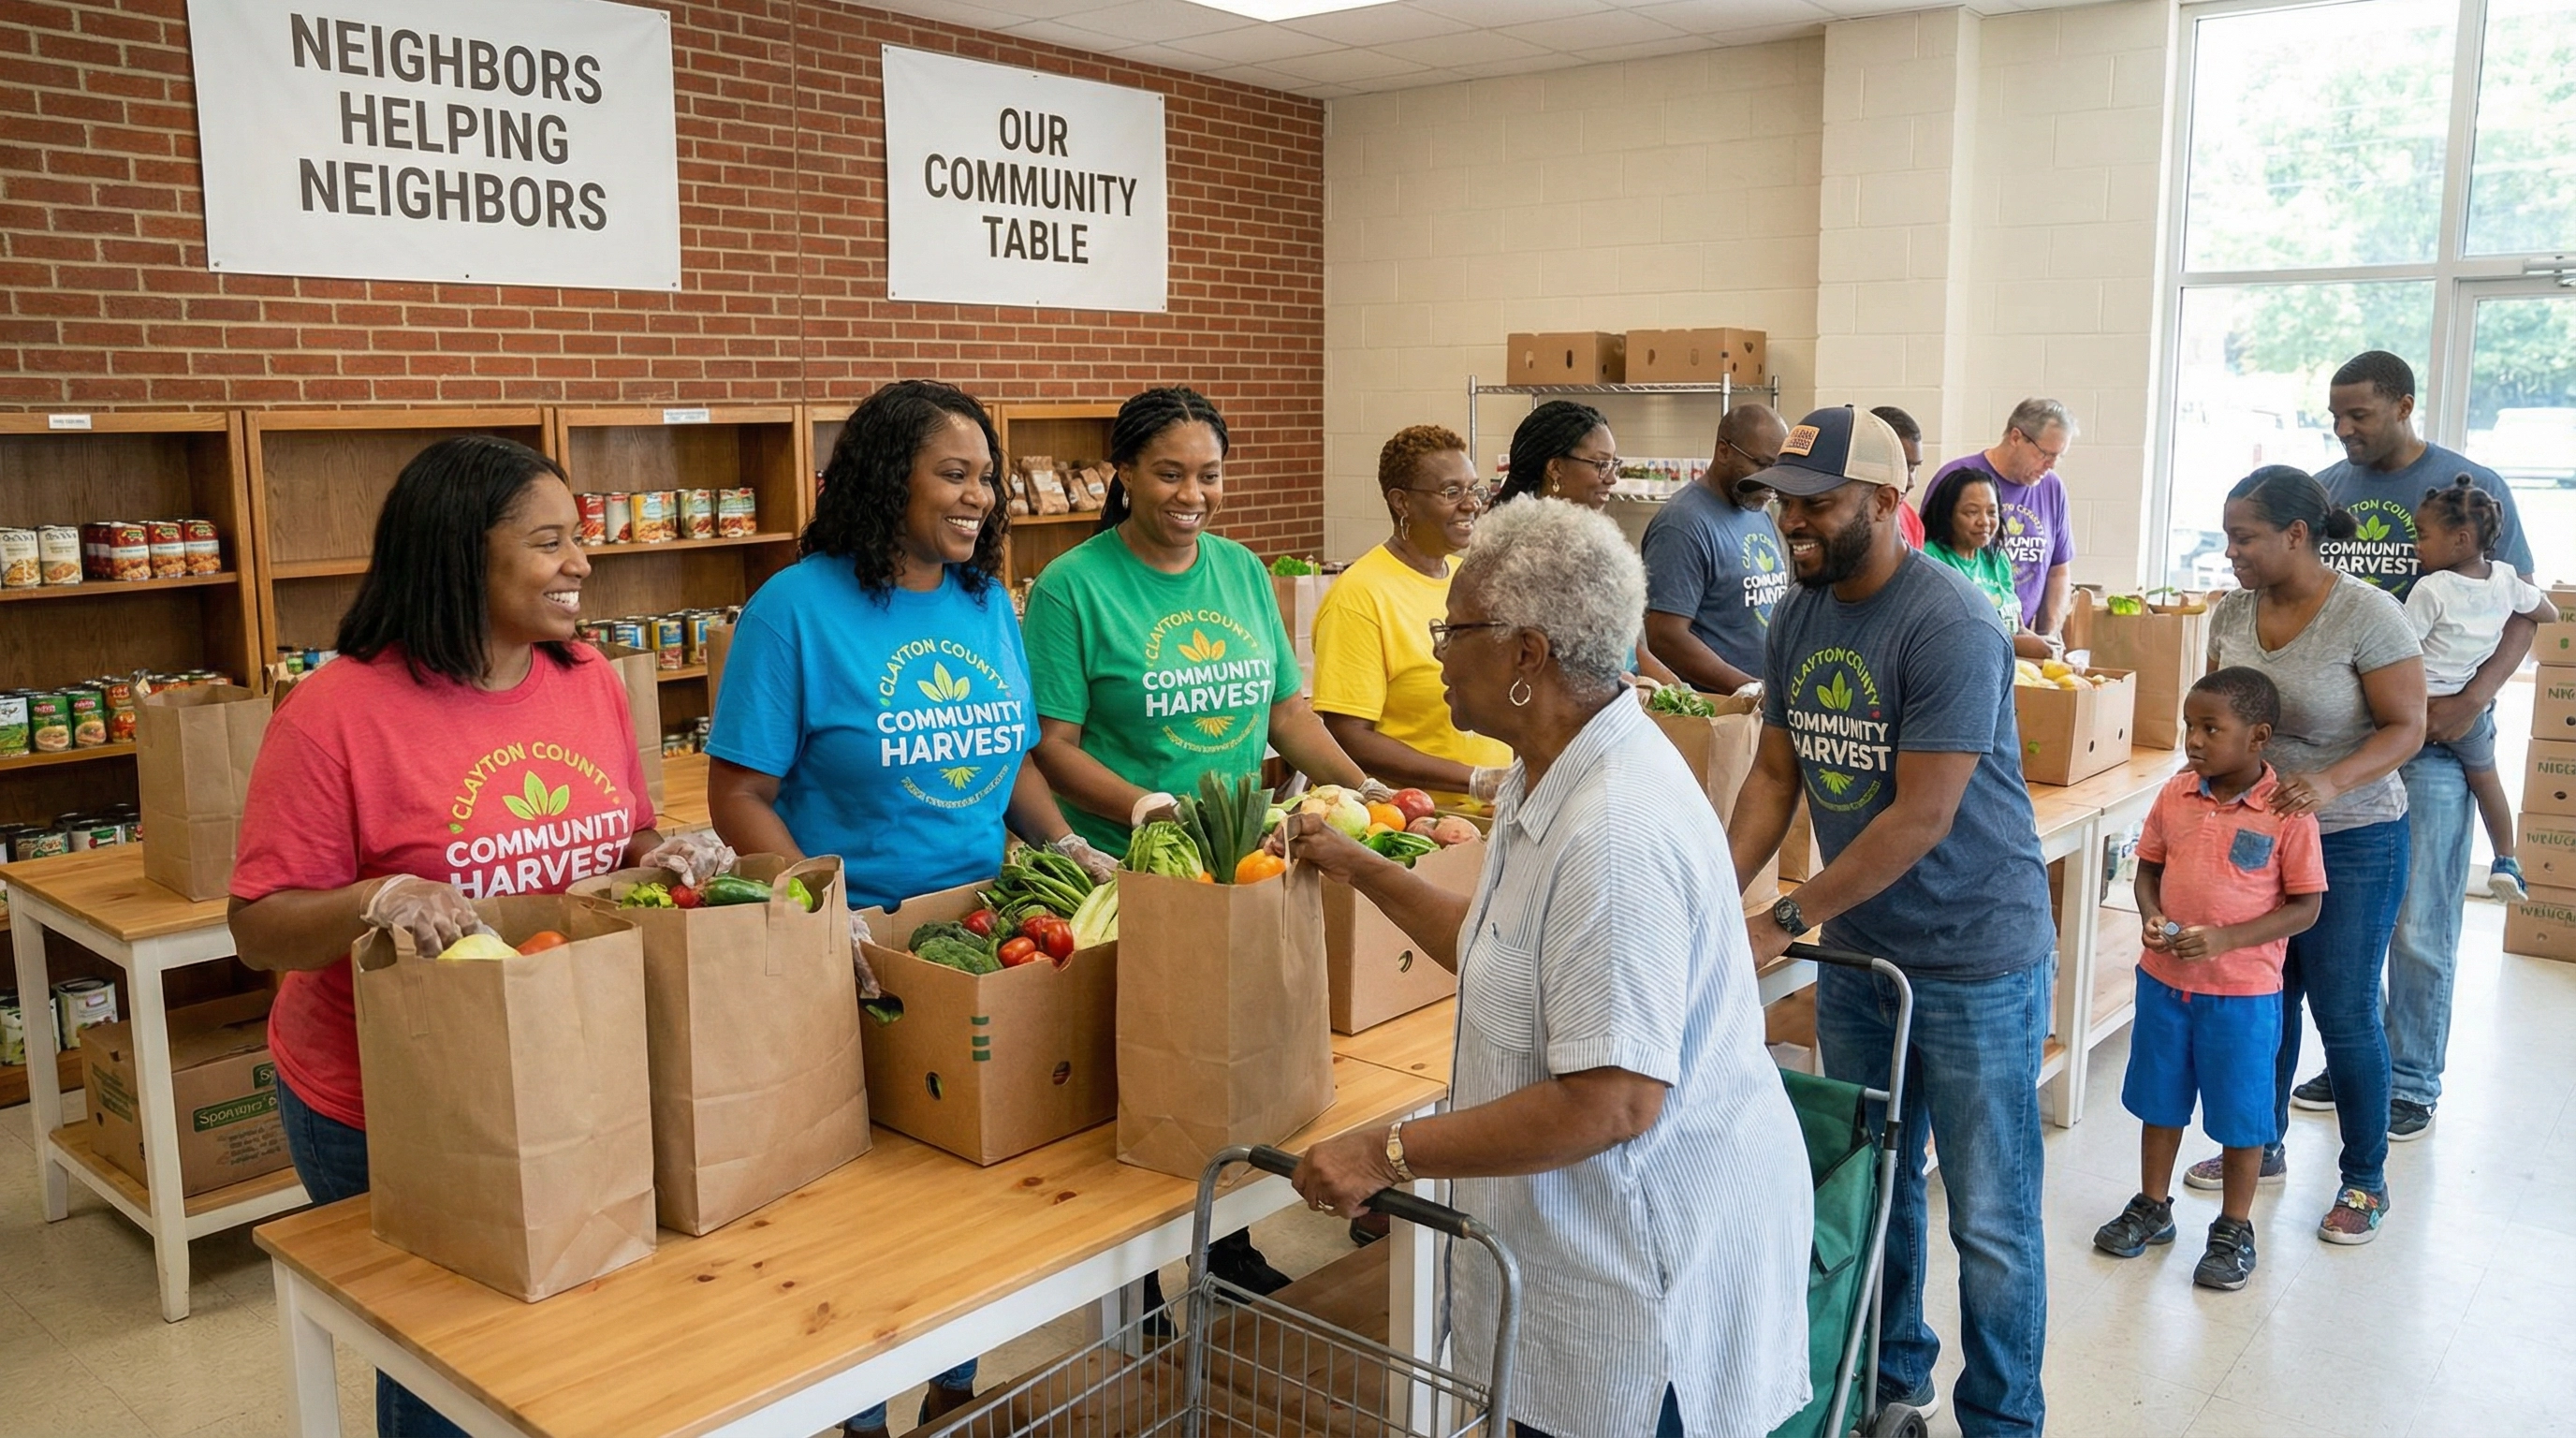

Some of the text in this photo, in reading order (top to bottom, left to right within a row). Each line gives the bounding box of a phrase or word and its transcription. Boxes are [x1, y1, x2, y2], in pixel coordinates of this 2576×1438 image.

[290, 12, 603, 105] NEIGHBORS
[340, 91, 569, 165] HELPING
[1000, 108, 1069, 157] OUR
[299, 158, 607, 232] NEIGHBORS
[925, 154, 1138, 217] COMMUNITY
[982, 215, 1089, 265] TABLE
[1146, 609, 1258, 661] CLAYTON COUNTY
[880, 638, 1010, 697] CLAYTON COUNTY
[1142, 658, 1270, 691] COMMUNITY
[1792, 647, 1846, 699] CLAYTON
[876, 700, 1021, 734] COMMUNITY
[1146, 680, 1271, 718] HARVEST
[881, 723, 1026, 768] HARVEST
[1787, 709, 1889, 742] COMMUNITY
[451, 741, 617, 820] CLAYTON COUNTY
[446, 807, 629, 868] COMMUNITY
[450, 837, 631, 899] HARVEST
